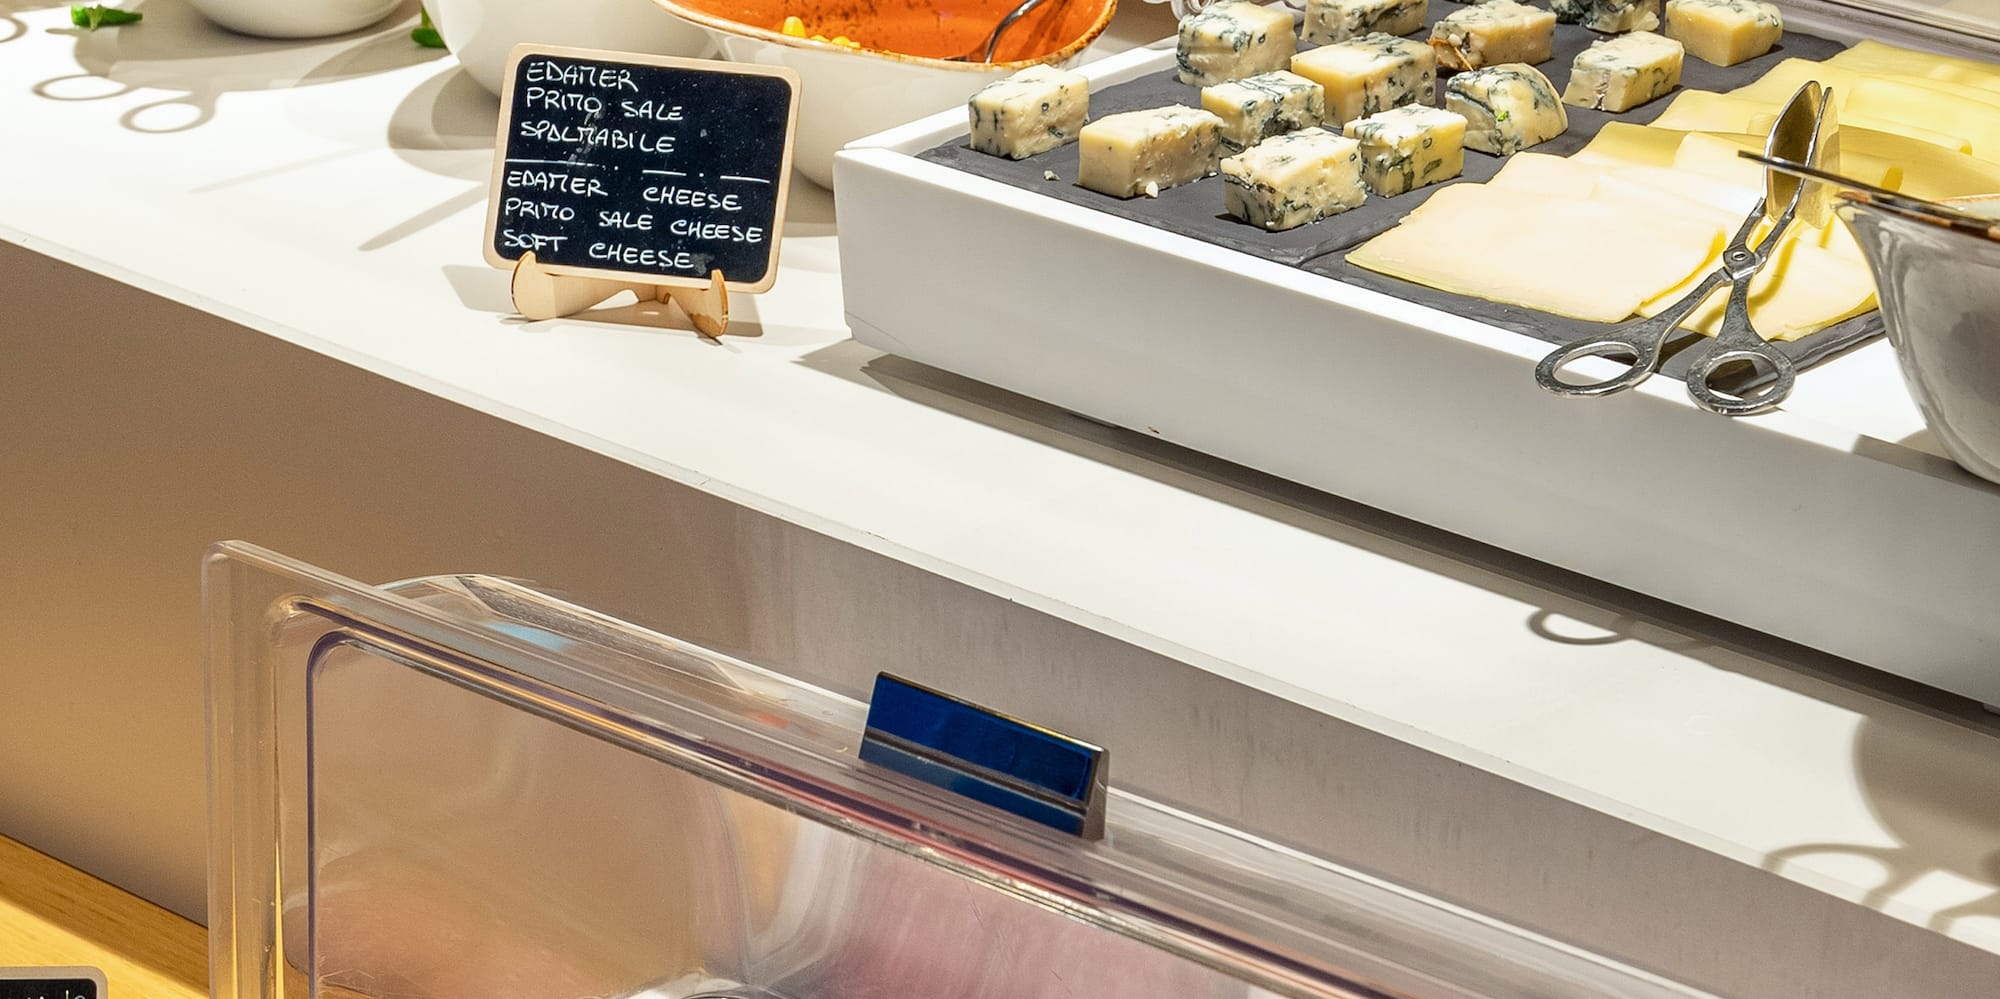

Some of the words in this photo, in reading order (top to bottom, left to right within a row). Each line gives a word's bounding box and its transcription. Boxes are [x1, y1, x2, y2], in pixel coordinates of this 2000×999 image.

[526, 87, 601, 113] PRIMO
[621, 100, 684, 121] SALE
[643, 186, 742, 211] CHEESE
[505, 198, 575, 221] PRIMO
[599, 211, 653, 230] SALE
[670, 219, 764, 243] CHEESE
[503, 229, 568, 252] SOFT
[589, 243, 694, 269] CHEESE
